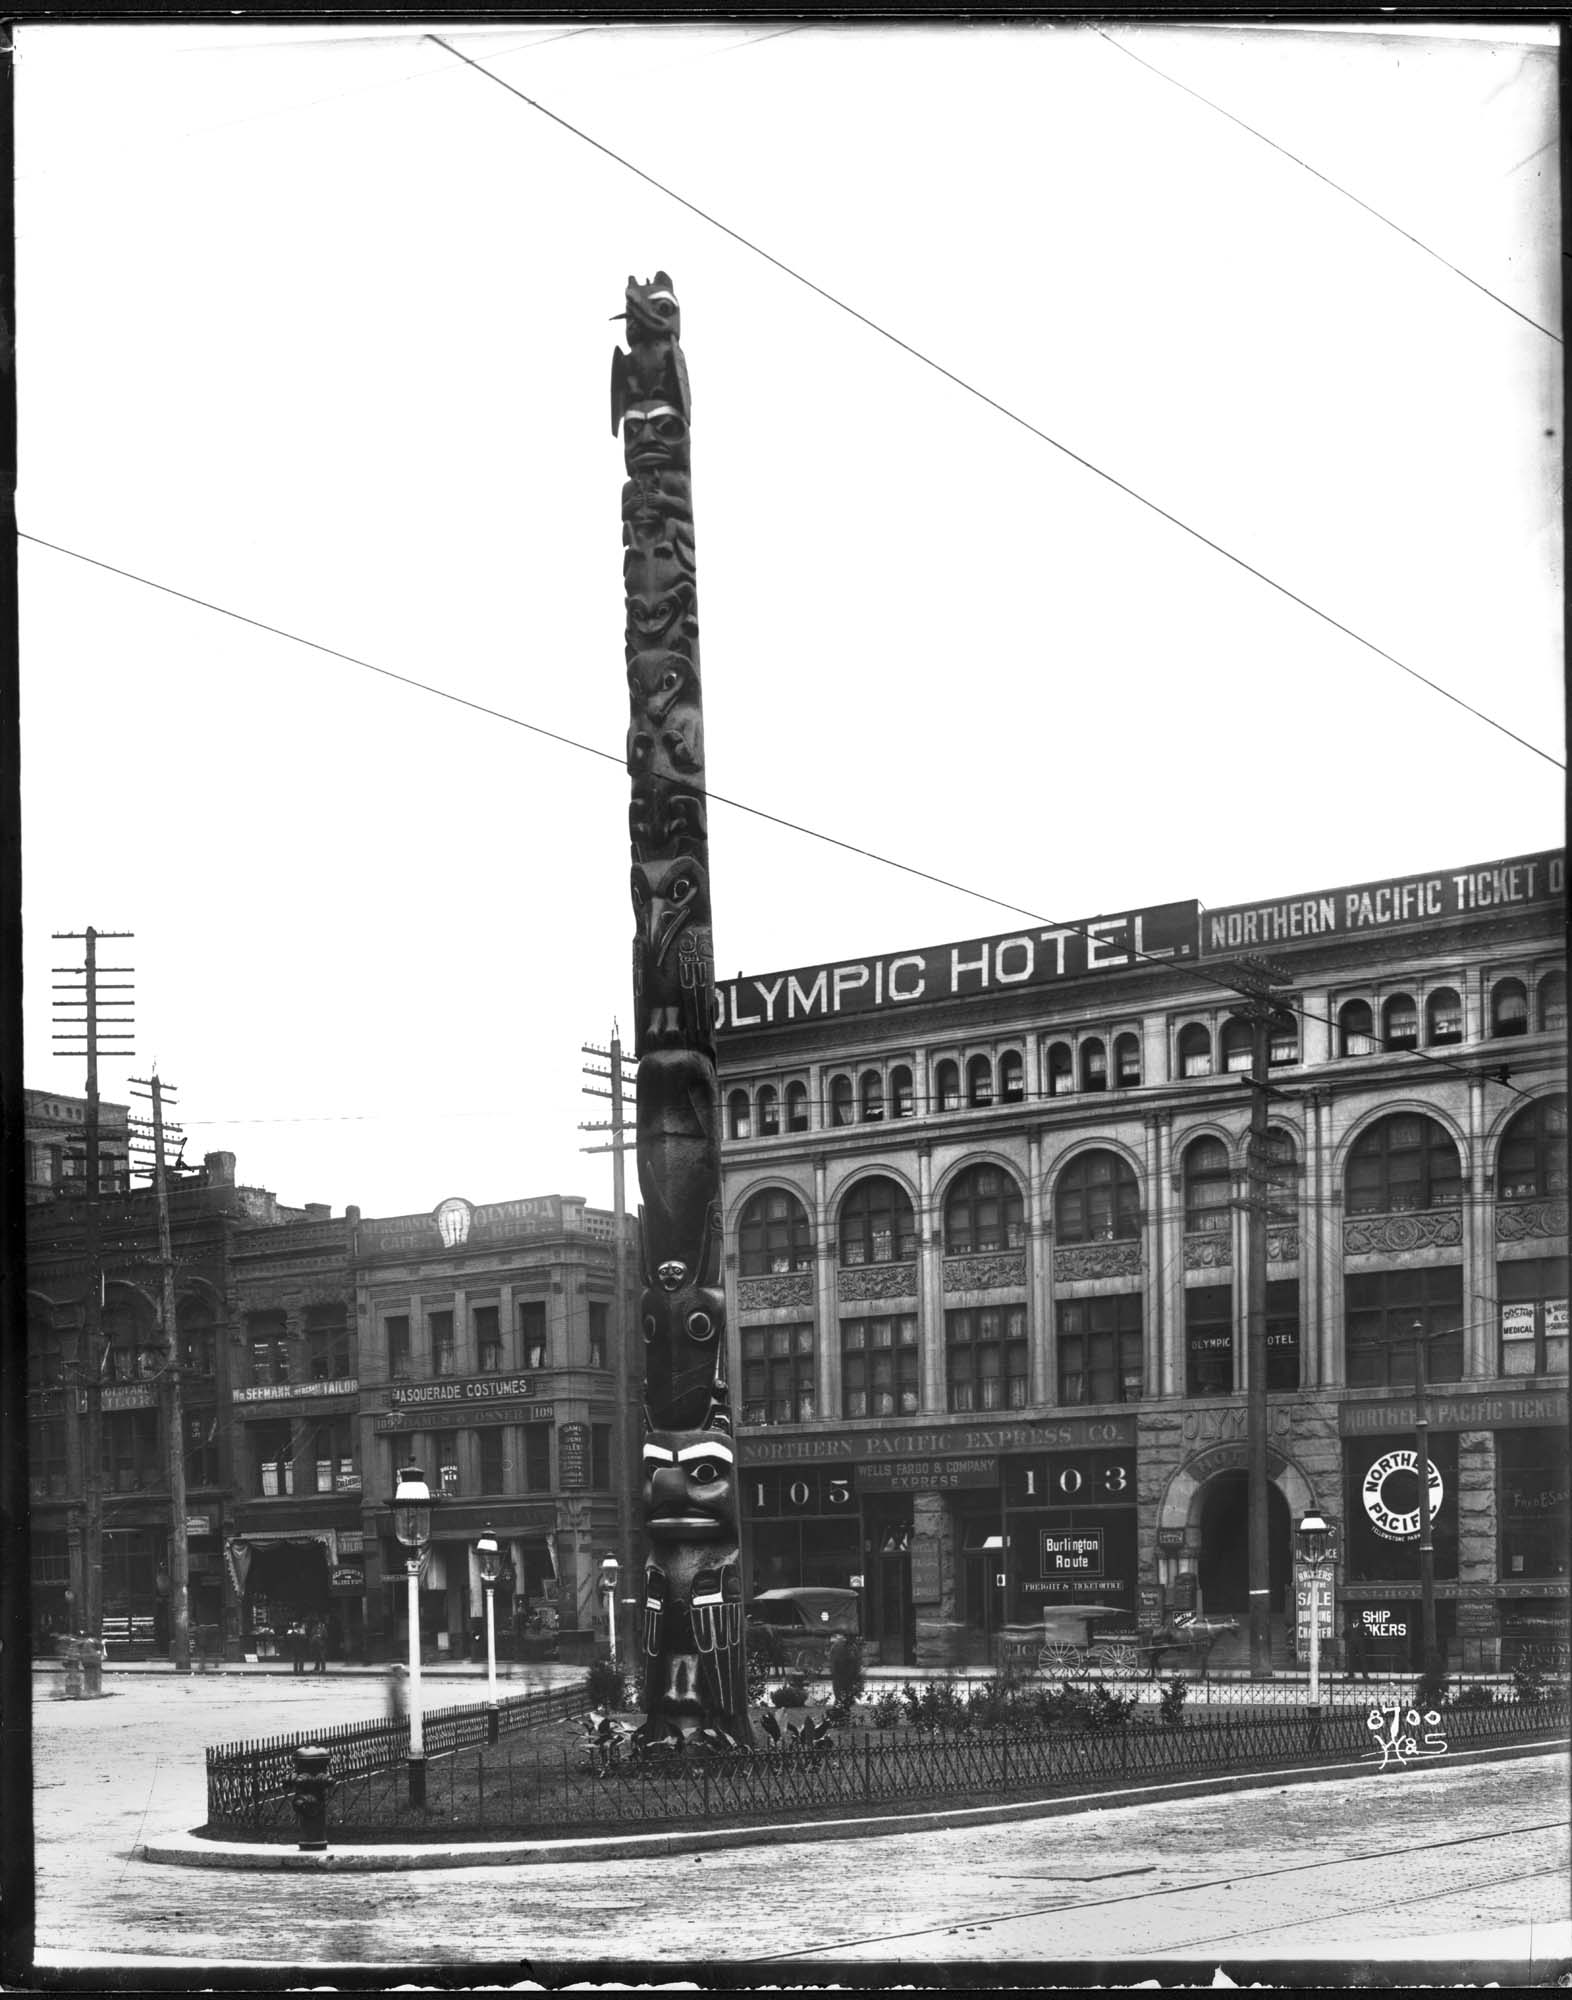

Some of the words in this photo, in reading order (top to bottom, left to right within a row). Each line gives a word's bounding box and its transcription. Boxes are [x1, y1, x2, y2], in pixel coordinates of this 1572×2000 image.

[1212, 898, 1336, 947] NORTHERN
[1346, 880, 1443, 927] PACIFIC
[1453, 862, 1538, 910] TICKET
[1504, 1325, 1534, 1335] MEDICAL
[1192, 1337, 1232, 1350] OLYMPIC
[1266, 1335, 1296, 1345] OTEL
[323, 1379, 358, 1395] TAILOR
[466, 1379, 528, 1397] COSTUMES
[535, 1406, 553, 1418] 109
[1439, 1400, 1503, 1424] PACIFIC
[1184, 1408, 1291, 1441] OLYMIC
[744, 1439, 853, 1459] NORTHERN
[866, 1433, 952, 1454] PACIFIC
[965, 1426, 1073, 1449] EXPRESS
[858, 1465, 892, 1478] WELLS
[946, 1459, 995, 1474] COMPANY
[892, 1475, 959, 1489] EXPRESS
[1046, 1538, 1099, 1554] Burlington
[1056, 1555, 1089, 1569] Route
[1362, 1610, 1391, 1623] SHIP
[1353, 1623, 1407, 1637] KERS
